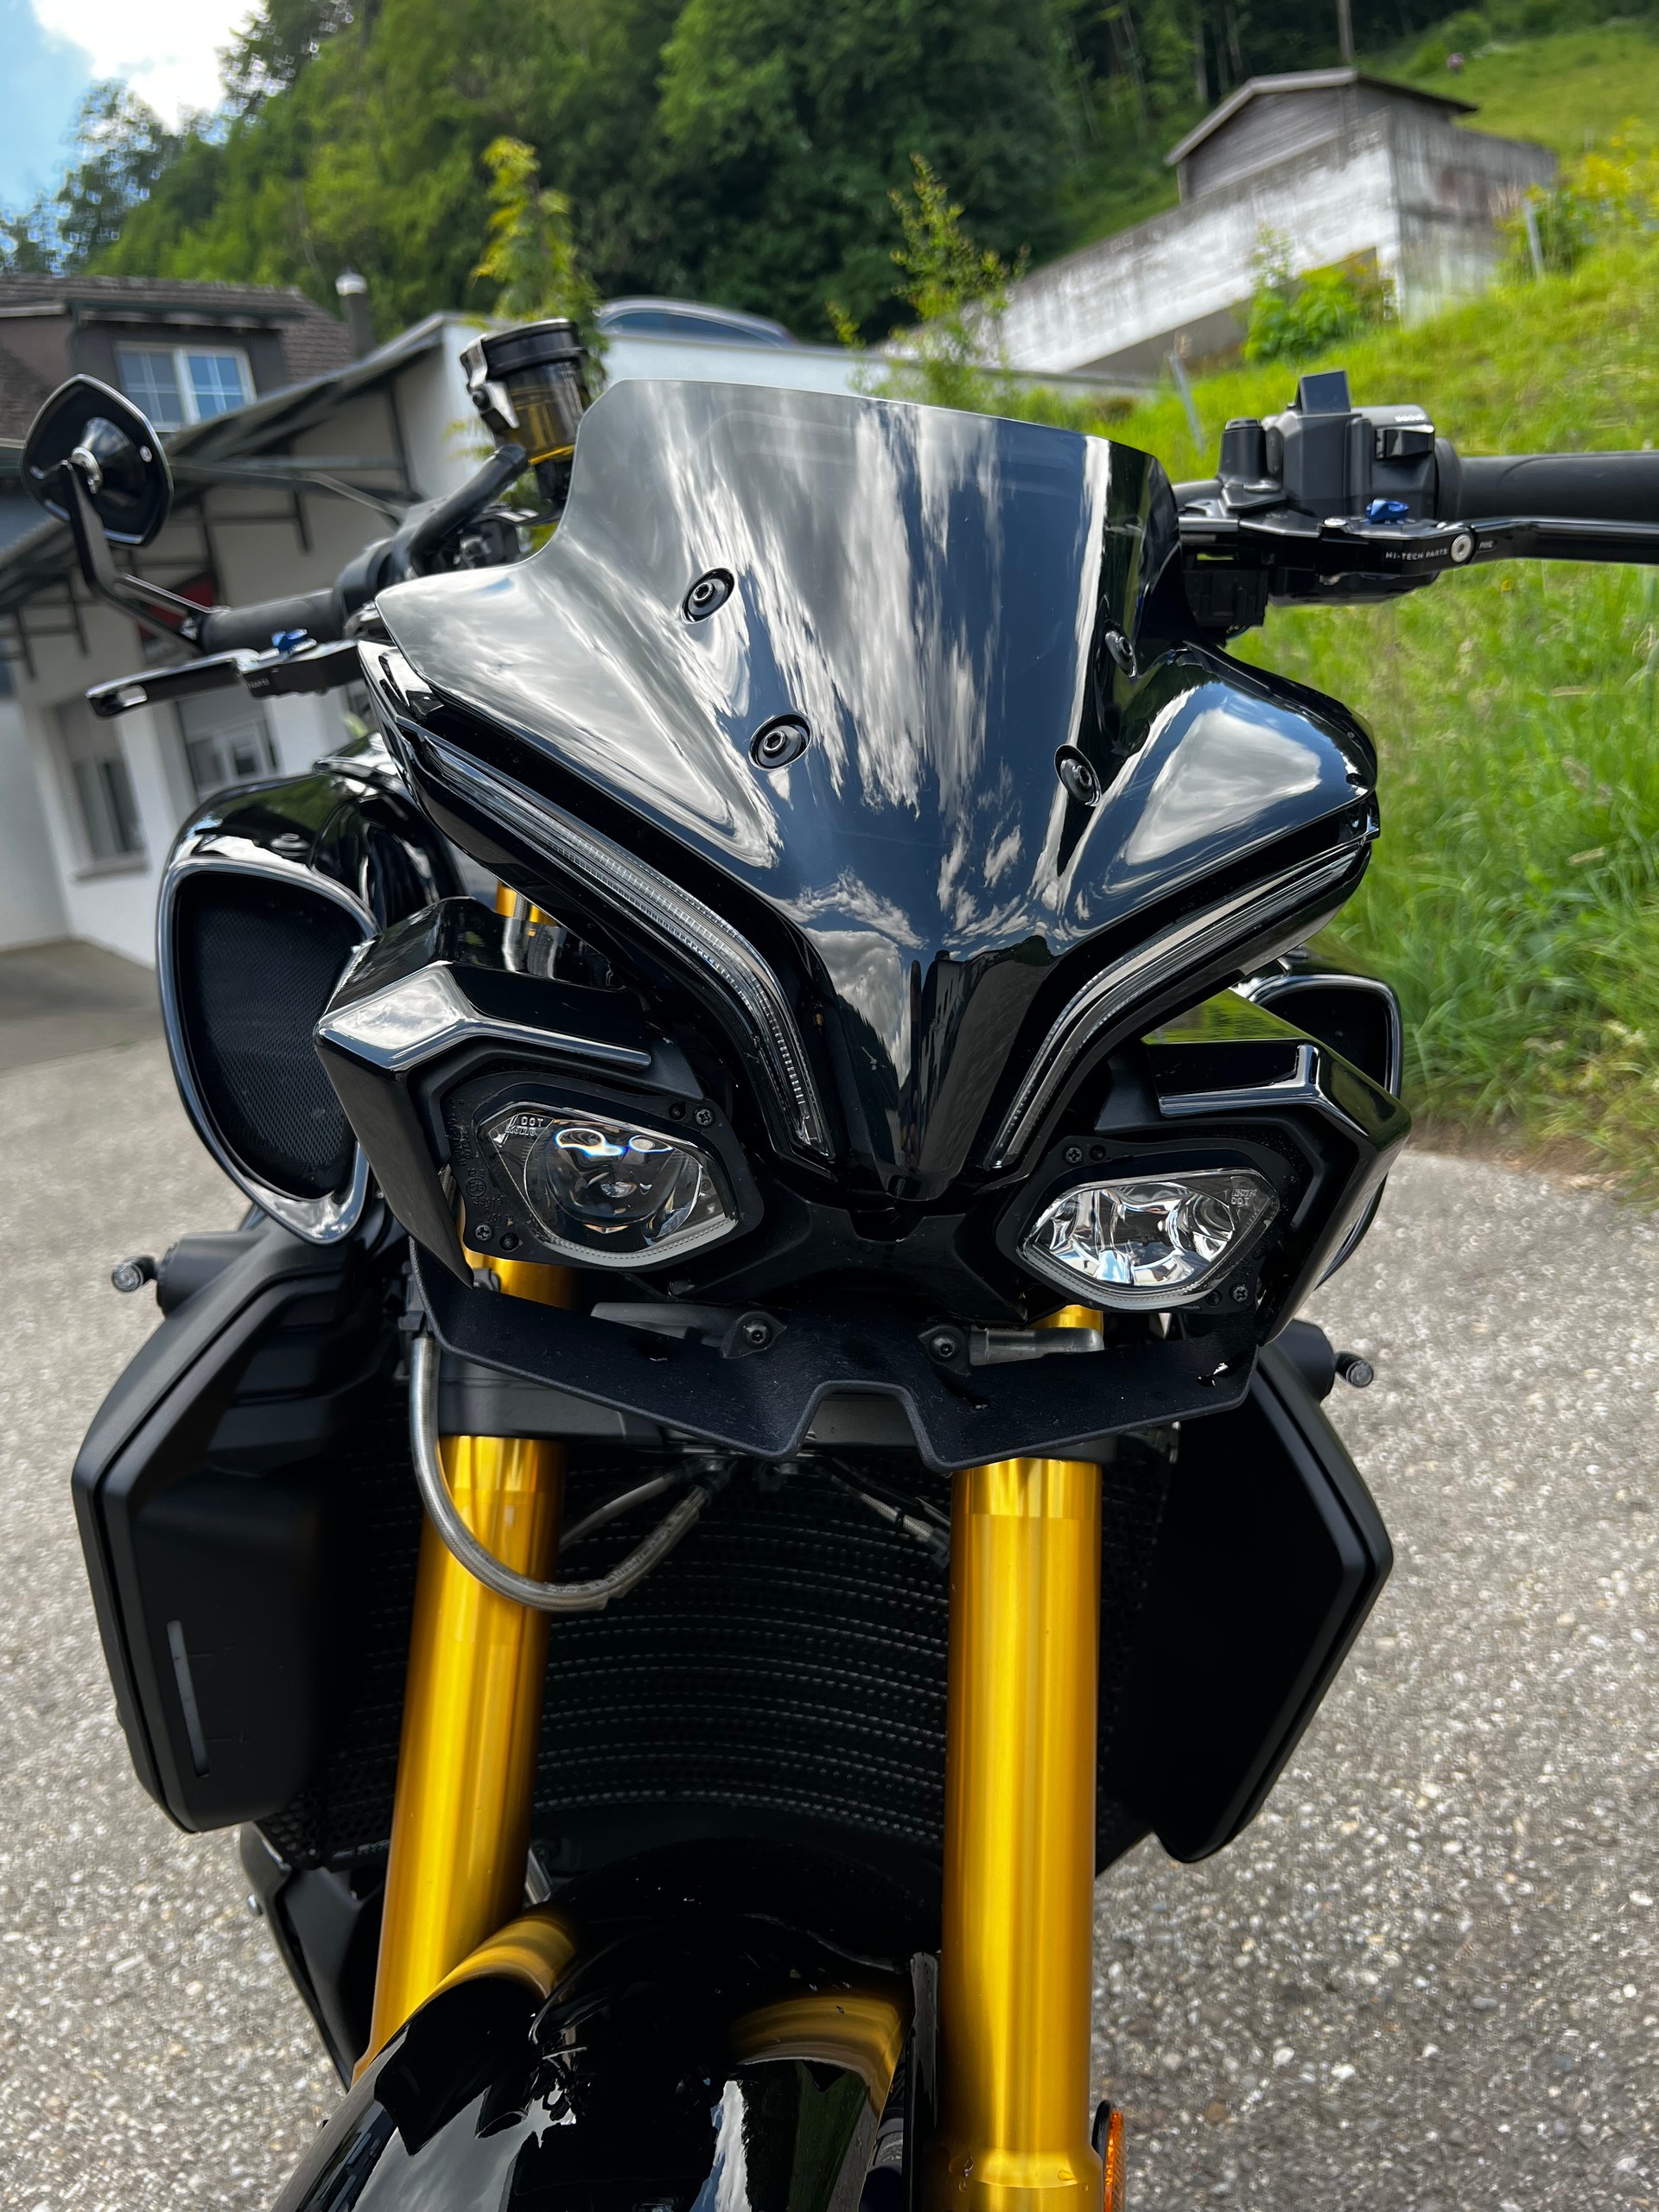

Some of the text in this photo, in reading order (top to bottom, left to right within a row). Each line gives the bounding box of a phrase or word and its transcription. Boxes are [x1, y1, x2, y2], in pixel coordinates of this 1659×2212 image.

[1385, 547, 1449, 561] HI-TECH PARTS
[521, 1116, 543, 1128] DOT
[1230, 1197, 1249, 1206] DOT
